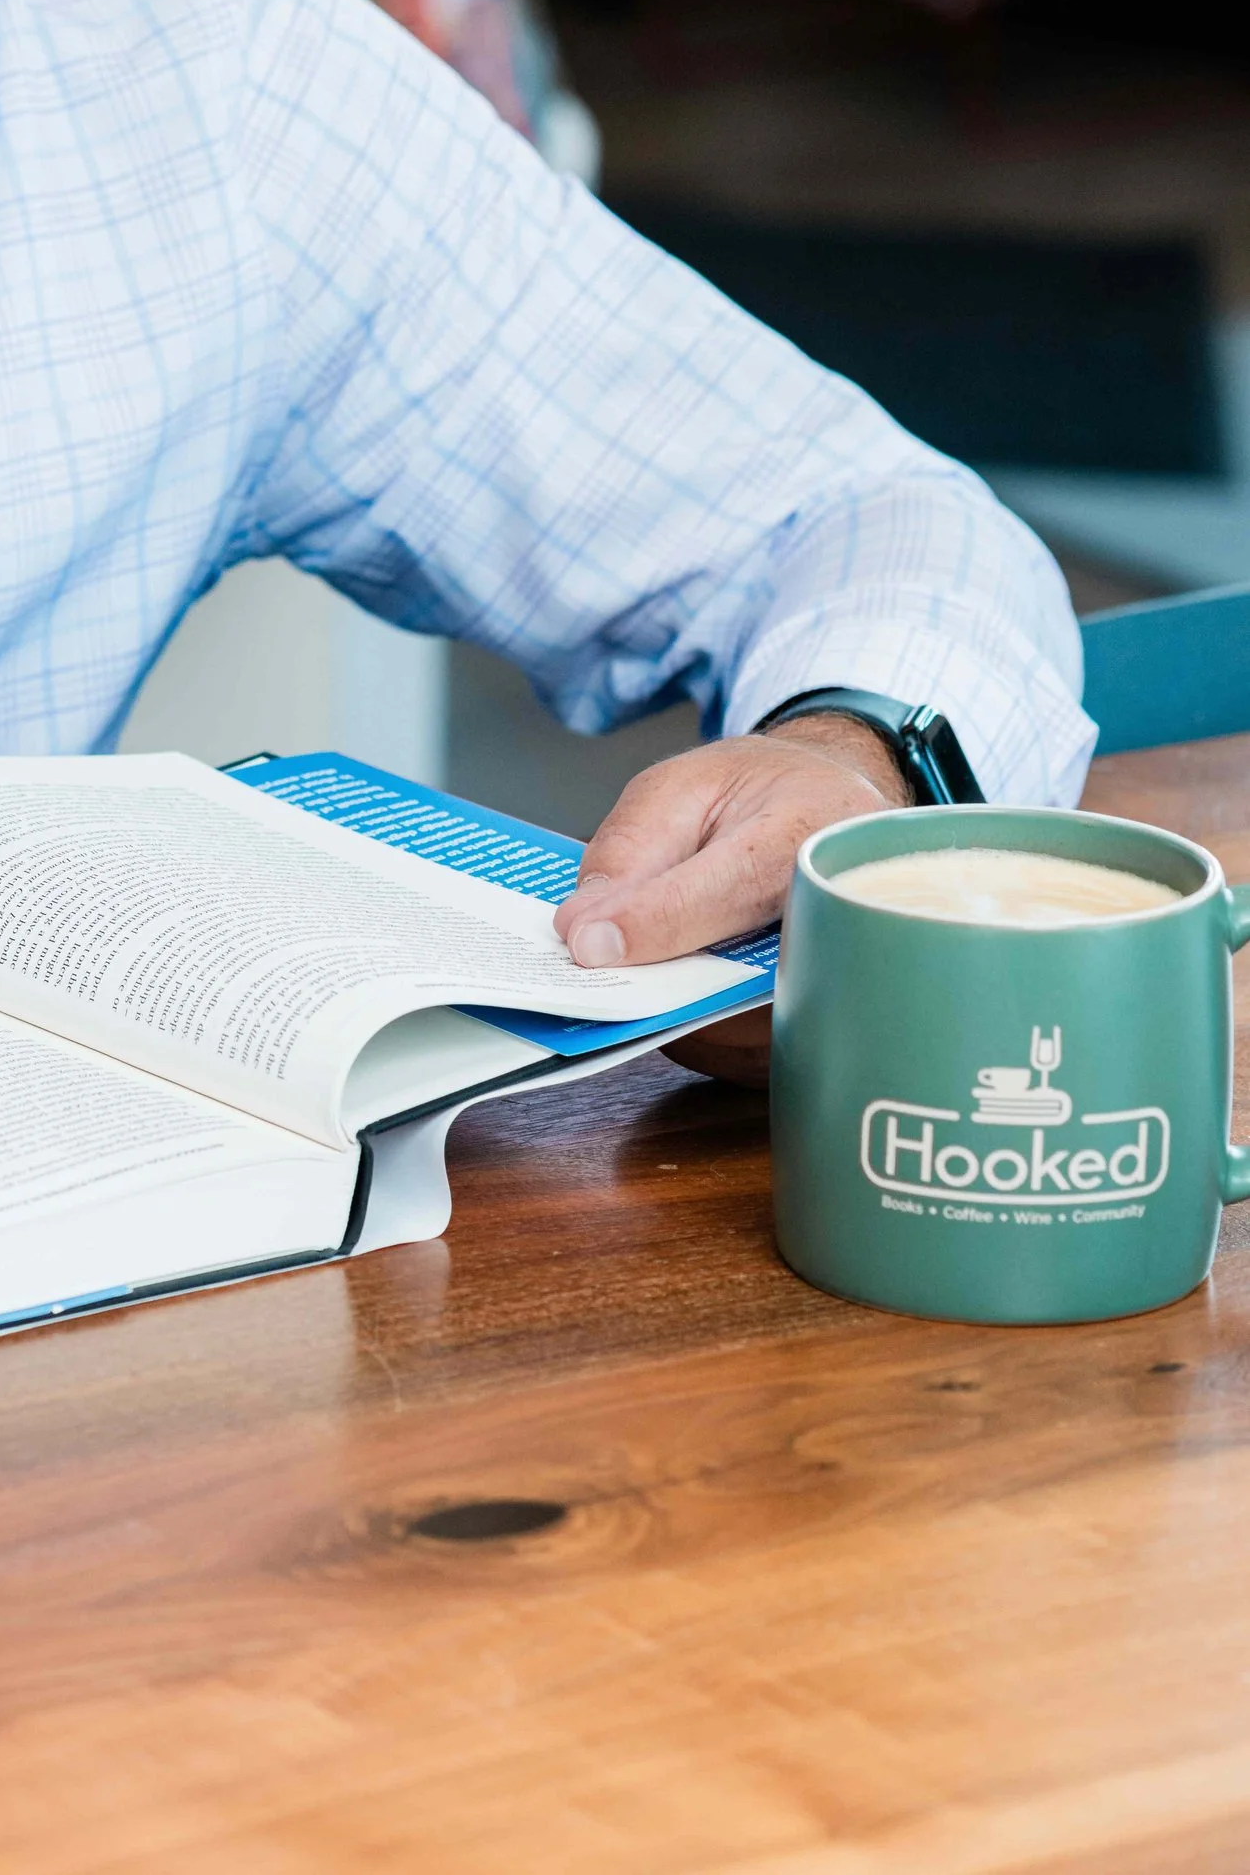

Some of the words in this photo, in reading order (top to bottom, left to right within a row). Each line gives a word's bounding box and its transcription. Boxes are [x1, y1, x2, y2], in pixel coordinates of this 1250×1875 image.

[505, 869, 541, 884] major
[17, 896, 27, 908] an
[43, 888, 88, 925] pursuing
[45, 887, 73, 909] could
[12, 908, 32, 934] echo
[25, 912, 47, 935] have
[48, 903, 84, 943] retained
[82, 905, 98, 919] not
[69, 921, 80, 933] an
[80, 913, 104, 938] party
[149, 926, 175, 946] more
[0, 937, 15, 965] both
[84, 925, 109, 952] effect
[118, 937, 129, 946] to
[729, 933, 781, 955] changes
[10, 939, 25, 970] done
[21, 942, 37, 974] more
[32, 947, 48, 979] more
[44, 935, 69, 983] outright
[54, 943, 80, 987] leaders,
[75, 955, 85, 970] on
[91, 953, 100, 966] or
[89, 950, 117, 1002] interpret
[118, 951, 146, 992] nuance
[124, 933, 185, 1005] understanding
[138, 946, 185, 1007] scholarship,
[183, 963, 198, 978] for
[66, 973, 76, 993] the
[146, 950, 196, 1026] contemporary
[112, 997, 119, 1012] or
[135, 1011, 140, 1021] is
[158, 981, 182, 1031] political
[217, 1033, 230, 1055] but
[229, 1047, 236, 1059] in
[265, 1053, 275, 1074] the
[885, 1116, 1148, 1191] Hooked
[881, 1194, 924, 1215] Books
[943, 1206, 994, 1223] Coffee
[1014, 1211, 1053, 1225] Wine
[1072, 1204, 1146, 1224] Community
